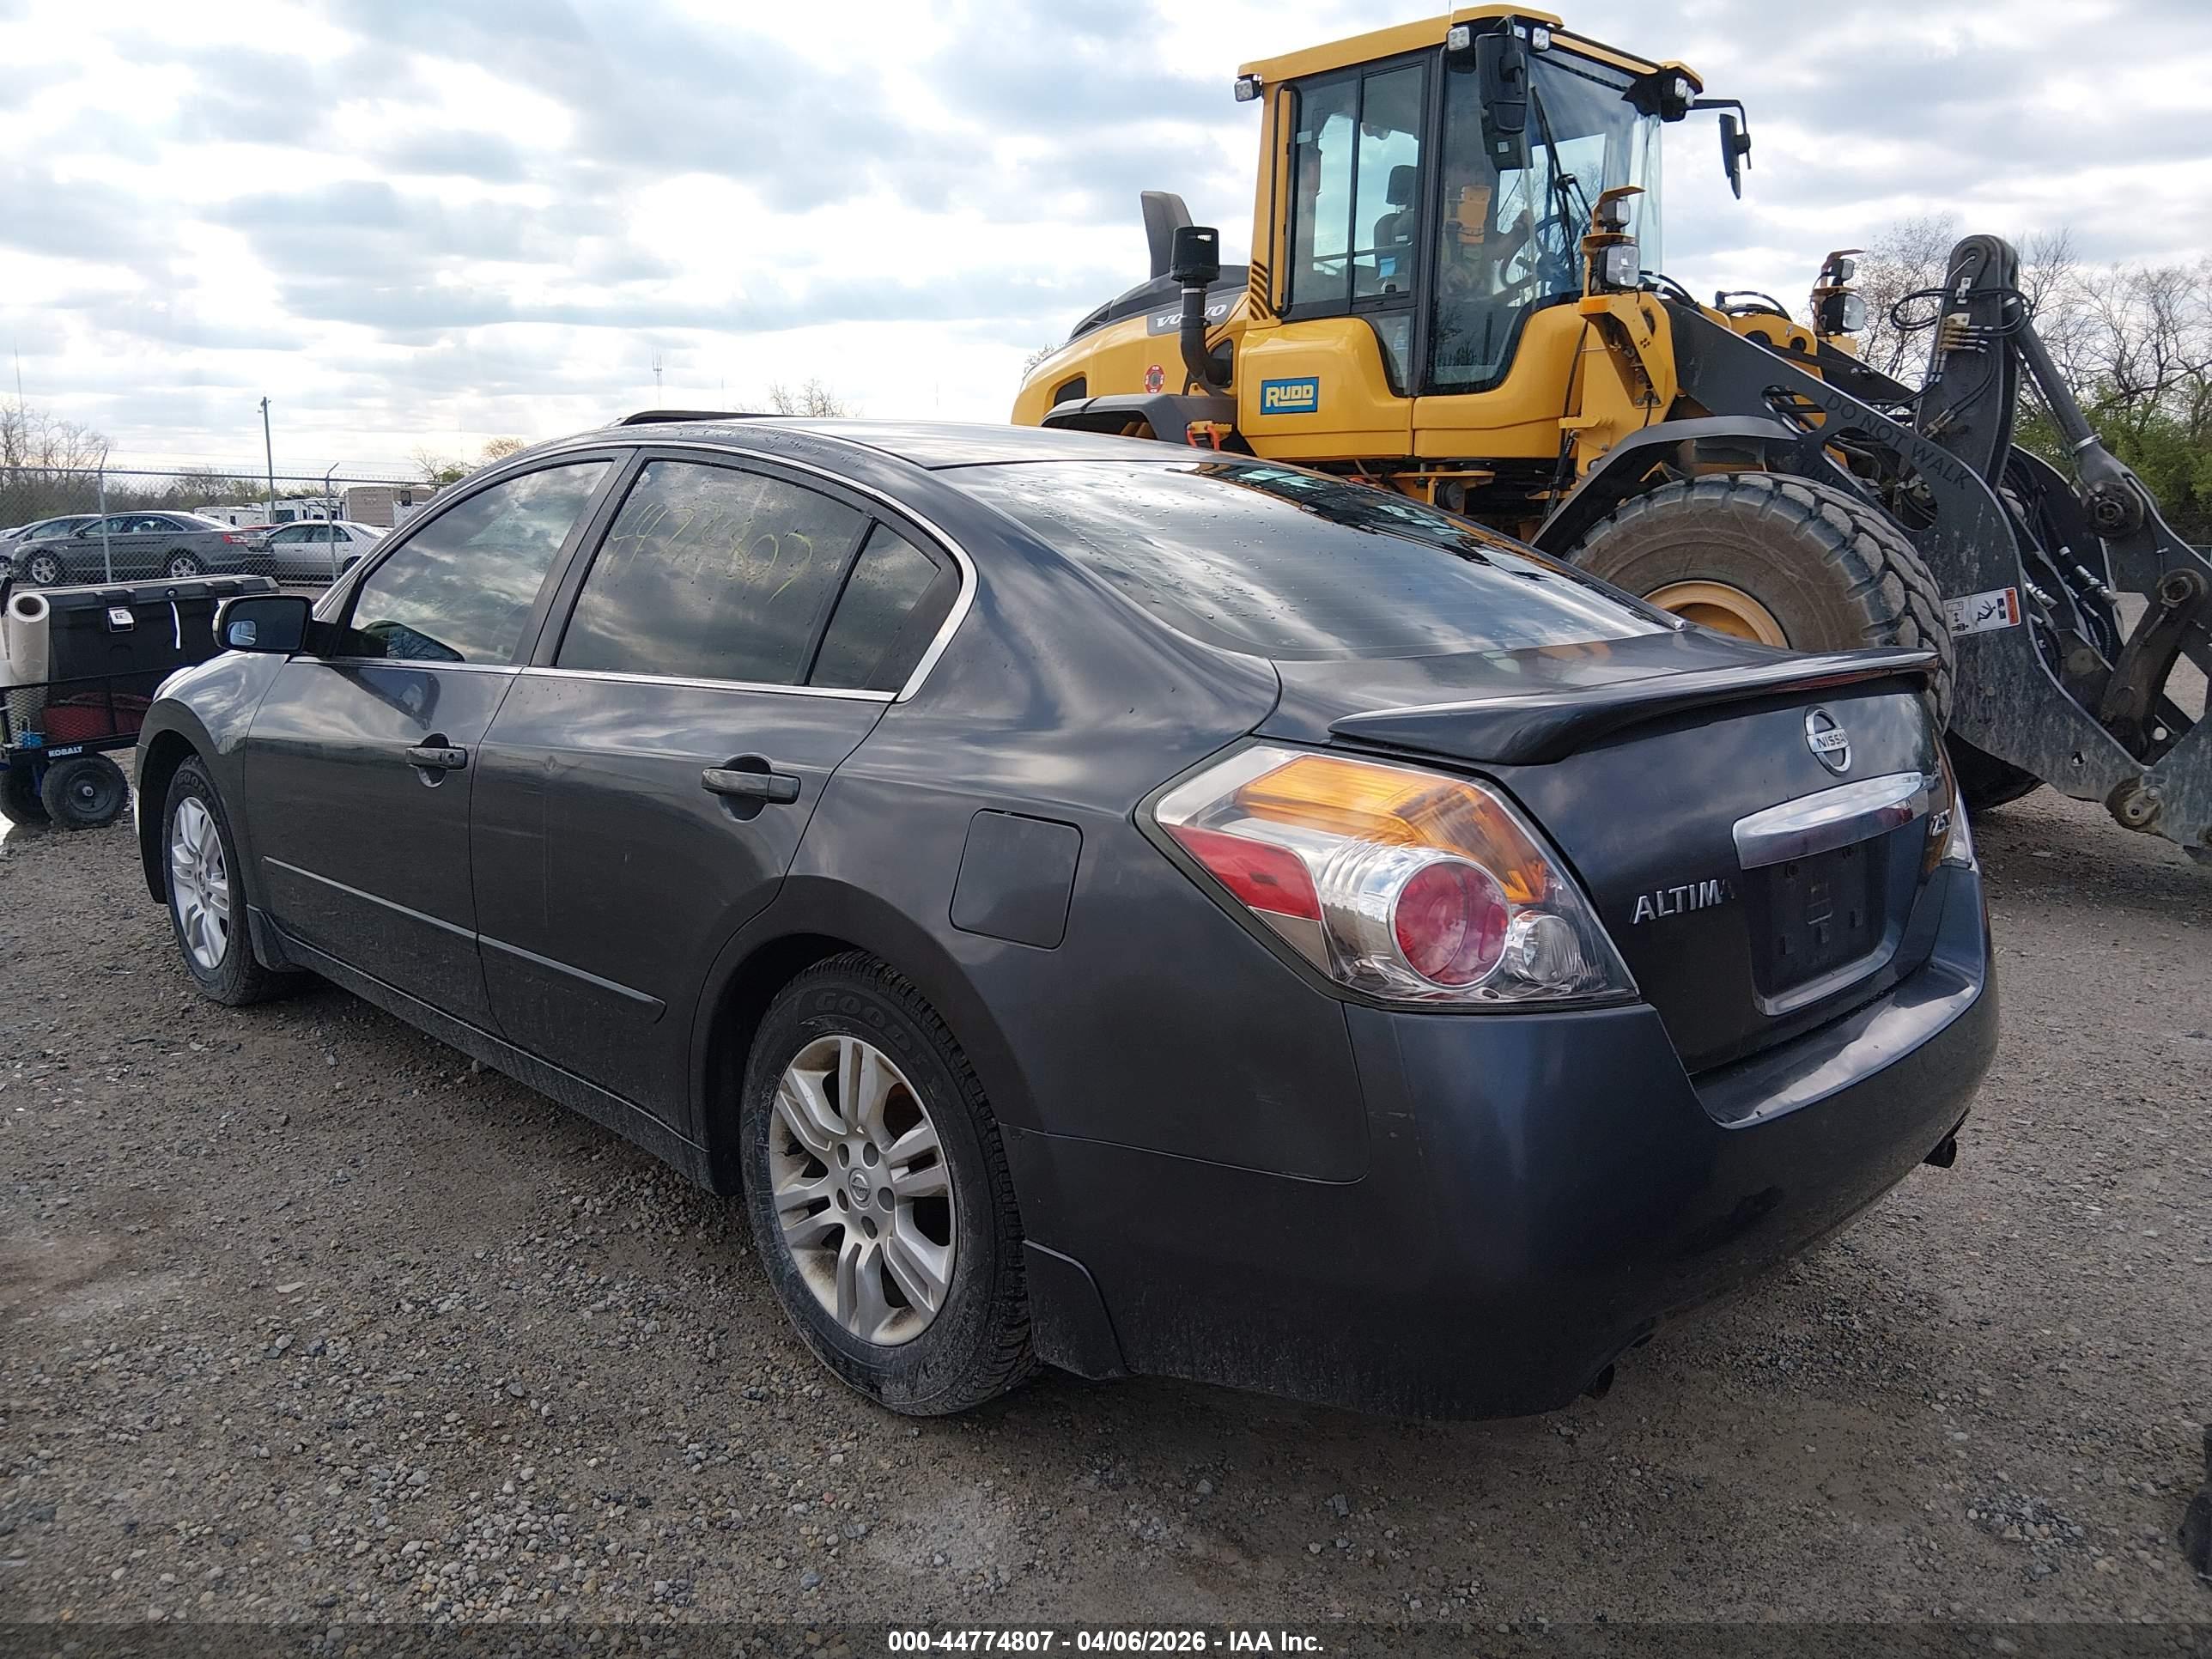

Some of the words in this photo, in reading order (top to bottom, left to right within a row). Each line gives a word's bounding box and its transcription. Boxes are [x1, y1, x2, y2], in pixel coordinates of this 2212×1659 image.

[1265, 385, 1314, 408] RUDD
[1825, 393, 1856, 420] DO
[1859, 414, 1908, 448] NOT
[1911, 441, 1973, 489] WALK
[48, 746, 82, 757] KOBALT
